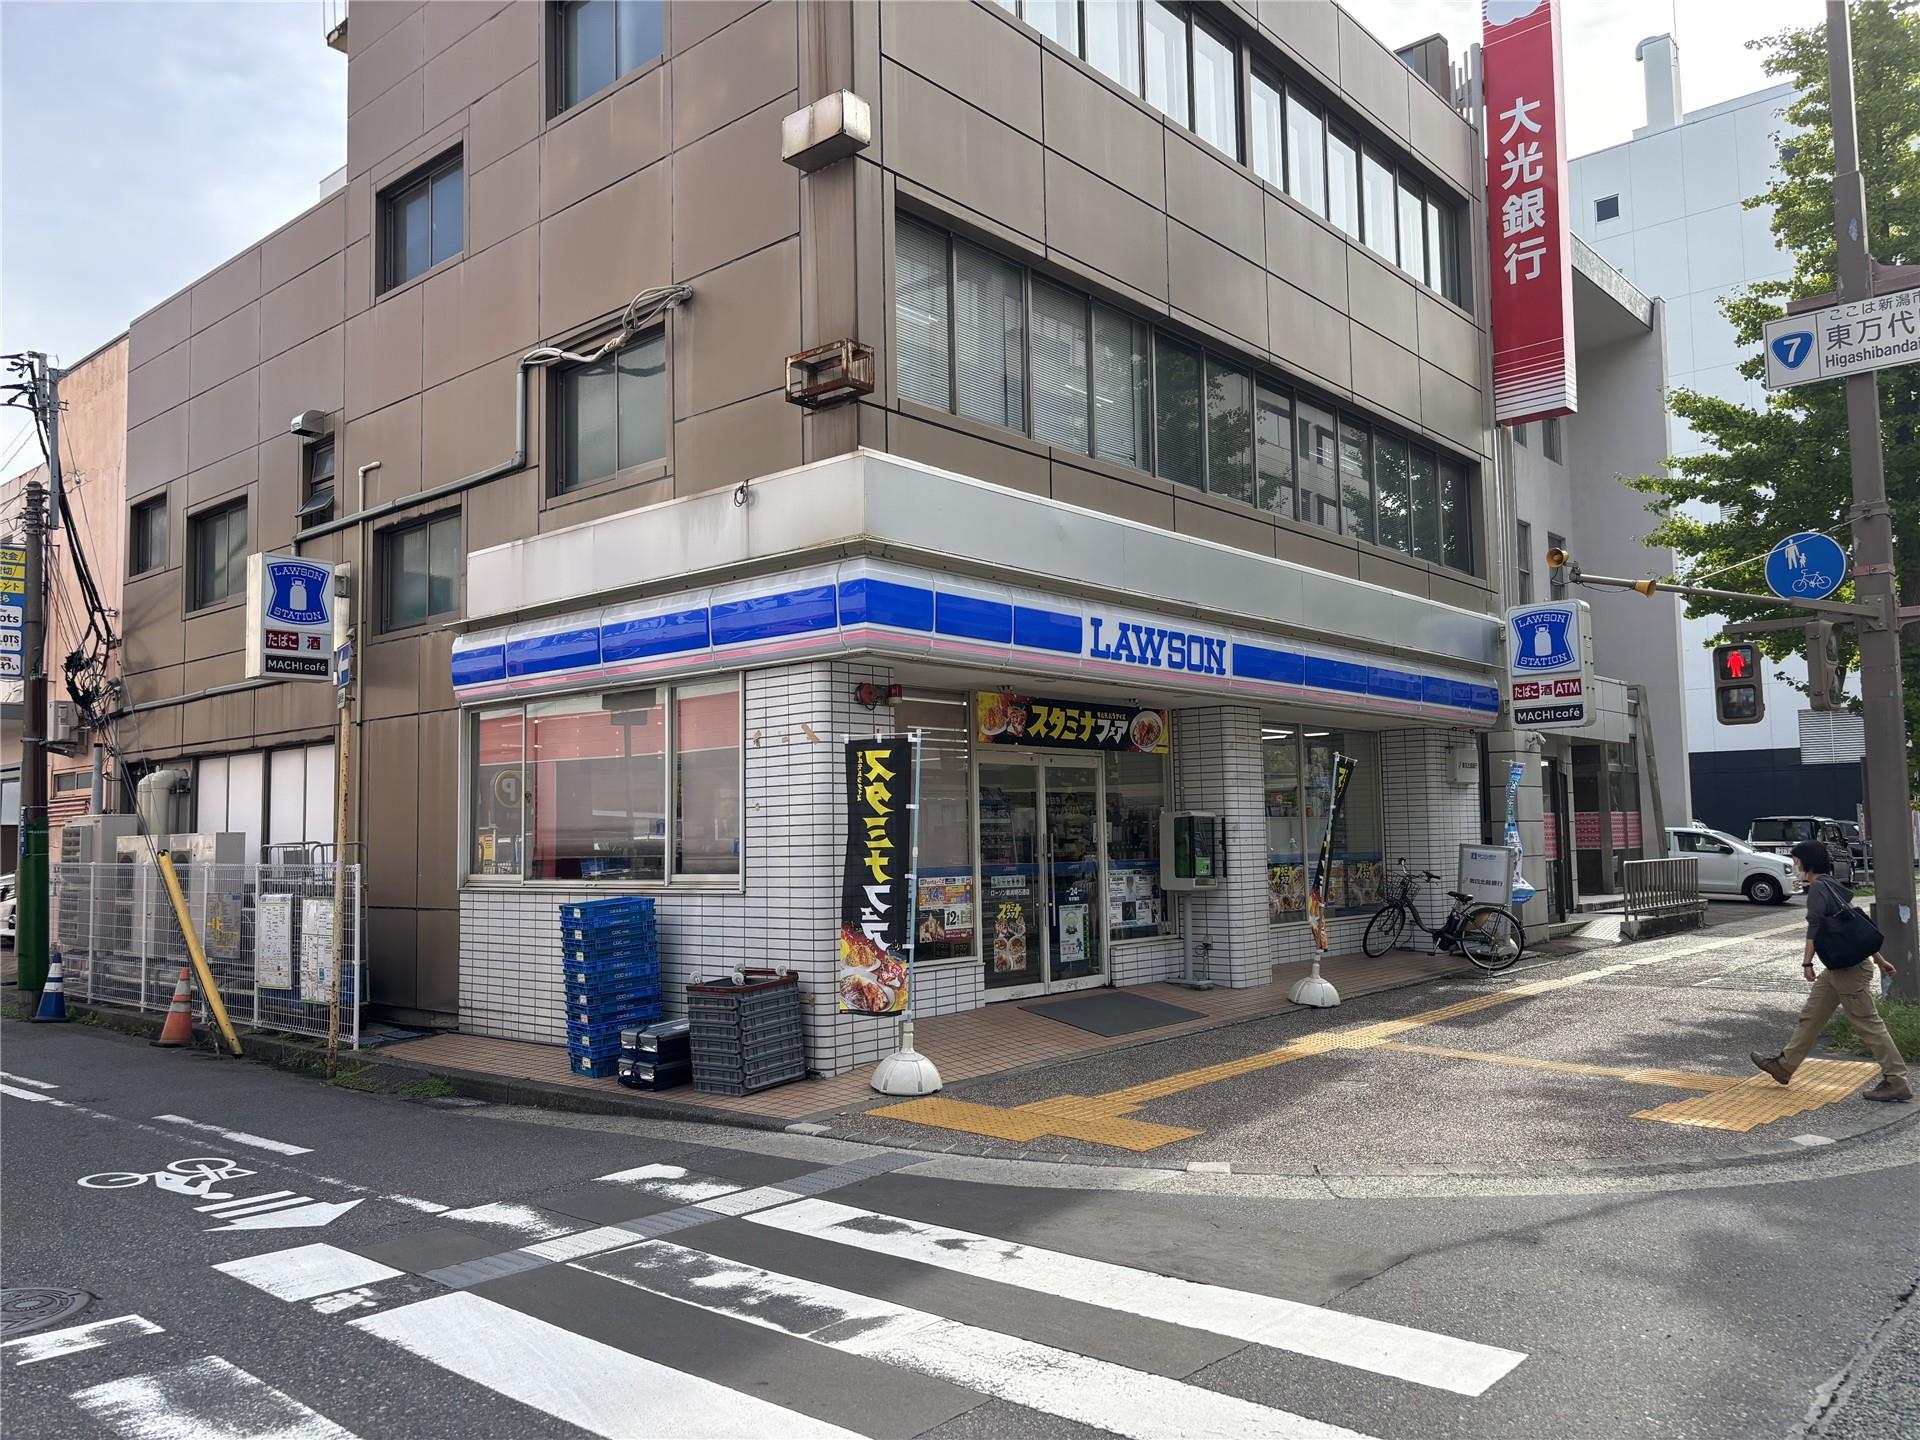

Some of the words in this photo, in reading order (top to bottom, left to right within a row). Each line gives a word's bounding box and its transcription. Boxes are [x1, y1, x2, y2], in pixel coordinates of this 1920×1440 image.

[1499, 96, 1547, 285] 大光銀行
[1826, 309, 1920, 351] 東万代
[1783, 338, 1801, 363] 7
[273, 567, 323, 582] LAWSON
[273, 606, 322, 621] STATION
[1518, 613, 1566, 628] LAWSON
[267, 632, 298, 649] たばこ
[306, 636, 321, 650] 酒
[1090, 617, 1226, 675] LAWSON
[267, 659, 303, 671] MACHI
[304, 663, 326, 672] café
[1520, 653, 1568, 666] STATION
[1514, 684, 1539, 698] たばこ
[1540, 684, 1553, 697] 酒
[1555, 681, 1580, 695] ATM
[1517, 710, 1554, 721] MACHI
[1556, 708, 1580, 718] café
[1027, 705, 1129, 744] スタミナフェア
